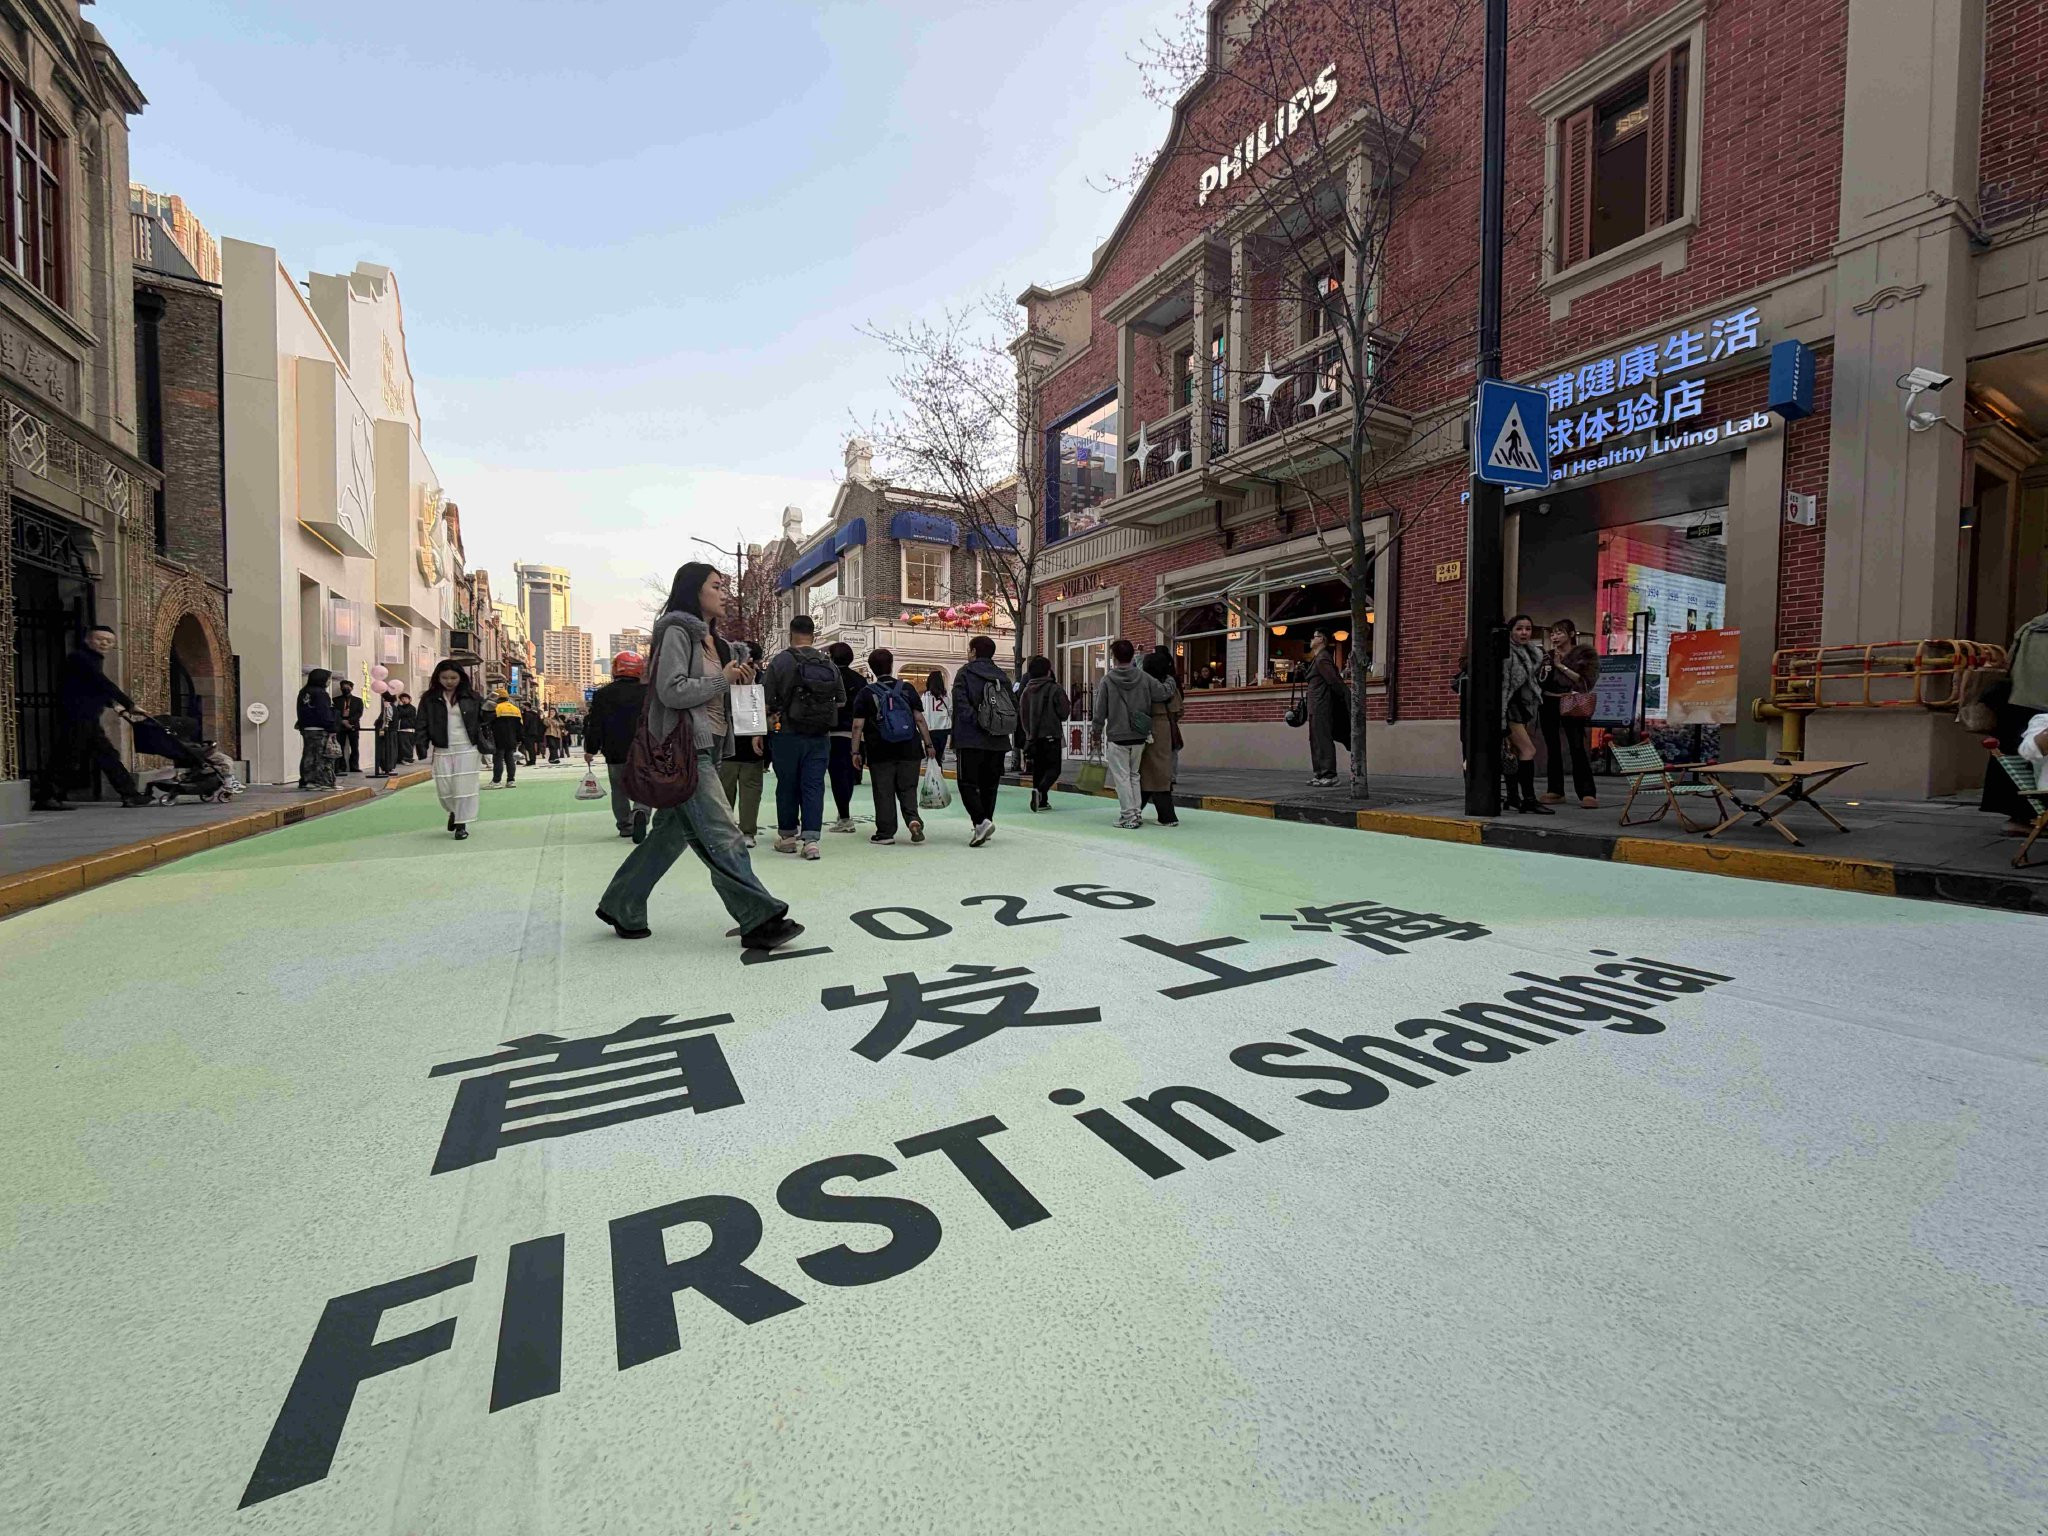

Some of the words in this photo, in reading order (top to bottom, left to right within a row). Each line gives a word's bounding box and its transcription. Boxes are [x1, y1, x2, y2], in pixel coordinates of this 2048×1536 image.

[1199, 62, 1338, 207] PHILIPS
[1530, 306, 1761, 414] 浦健康生活
[1573, 444, 1648, 475] Healthy
[1653, 427, 1718, 455] Living
[1725, 410, 1769, 437] Lab
[1438, 563, 1458, 575] 249
[932, 697, 944, 712] 12
[428, 900, 1493, 1177] 首发上海
[236, 1114, 1054, 1511] FIRST
[1048, 1085, 1286, 1181] in
[1228, 949, 1736, 1111] Shanghai
